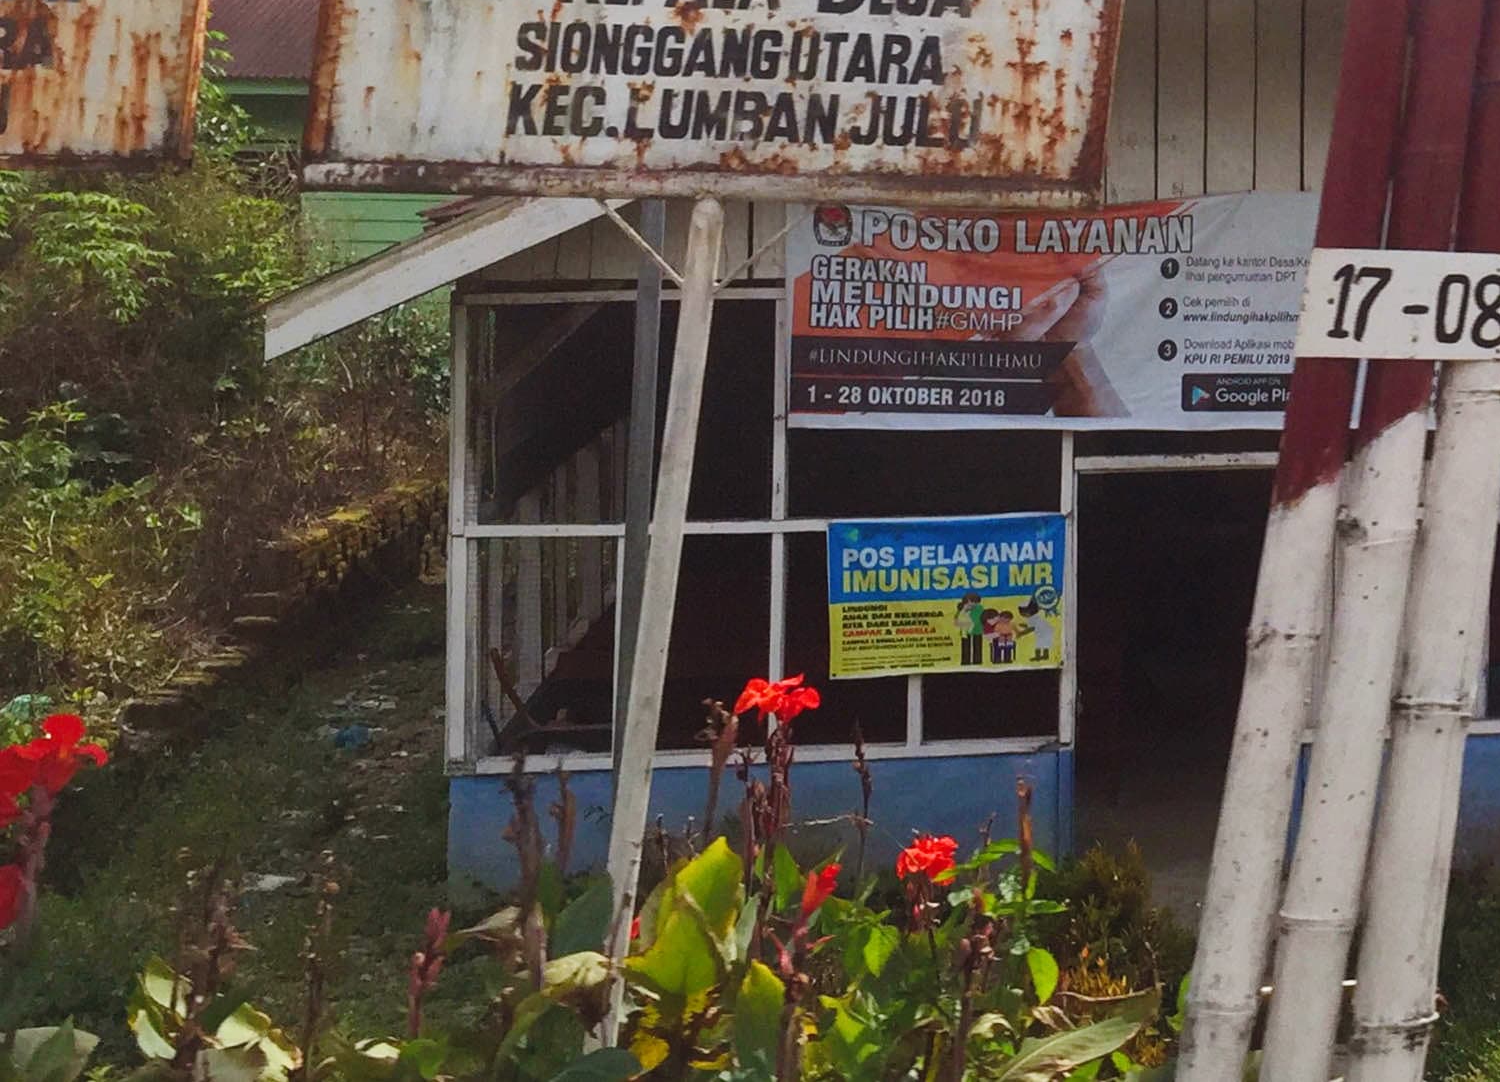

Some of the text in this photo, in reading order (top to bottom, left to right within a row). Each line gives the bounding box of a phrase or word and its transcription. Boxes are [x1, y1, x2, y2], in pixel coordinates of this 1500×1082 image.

[513, 20, 946, 86] SIONGGANG UTARA
[847, 93, 983, 149] JULU
[860, 209, 1194, 254] POSKO LAYANAN
[810, 254, 928, 284] GERAKAN
[1275, 270, 1297, 282] DPT
[810, 279, 1023, 311] MELINDUNGI
[809, 302, 1024, 332] HAK PILIH #GMHP
[808, 348, 1042, 368] #LINDUNGIHAKPILIHMU
[1184, 337, 1233, 350] Download
[1183, 353, 1291, 365] KPU RI PEMILU 2019
[807, 385, 816, 403] 1
[838, 386, 862, 404] 28
[868, 386, 953, 406] OKTOBER
[959, 388, 1006, 406] 2018
[1215, 387, 1270, 407] Google
[842, 540, 1054, 569] POS PELAYANAN
[842, 561, 1054, 594] IMUNISASI MR
